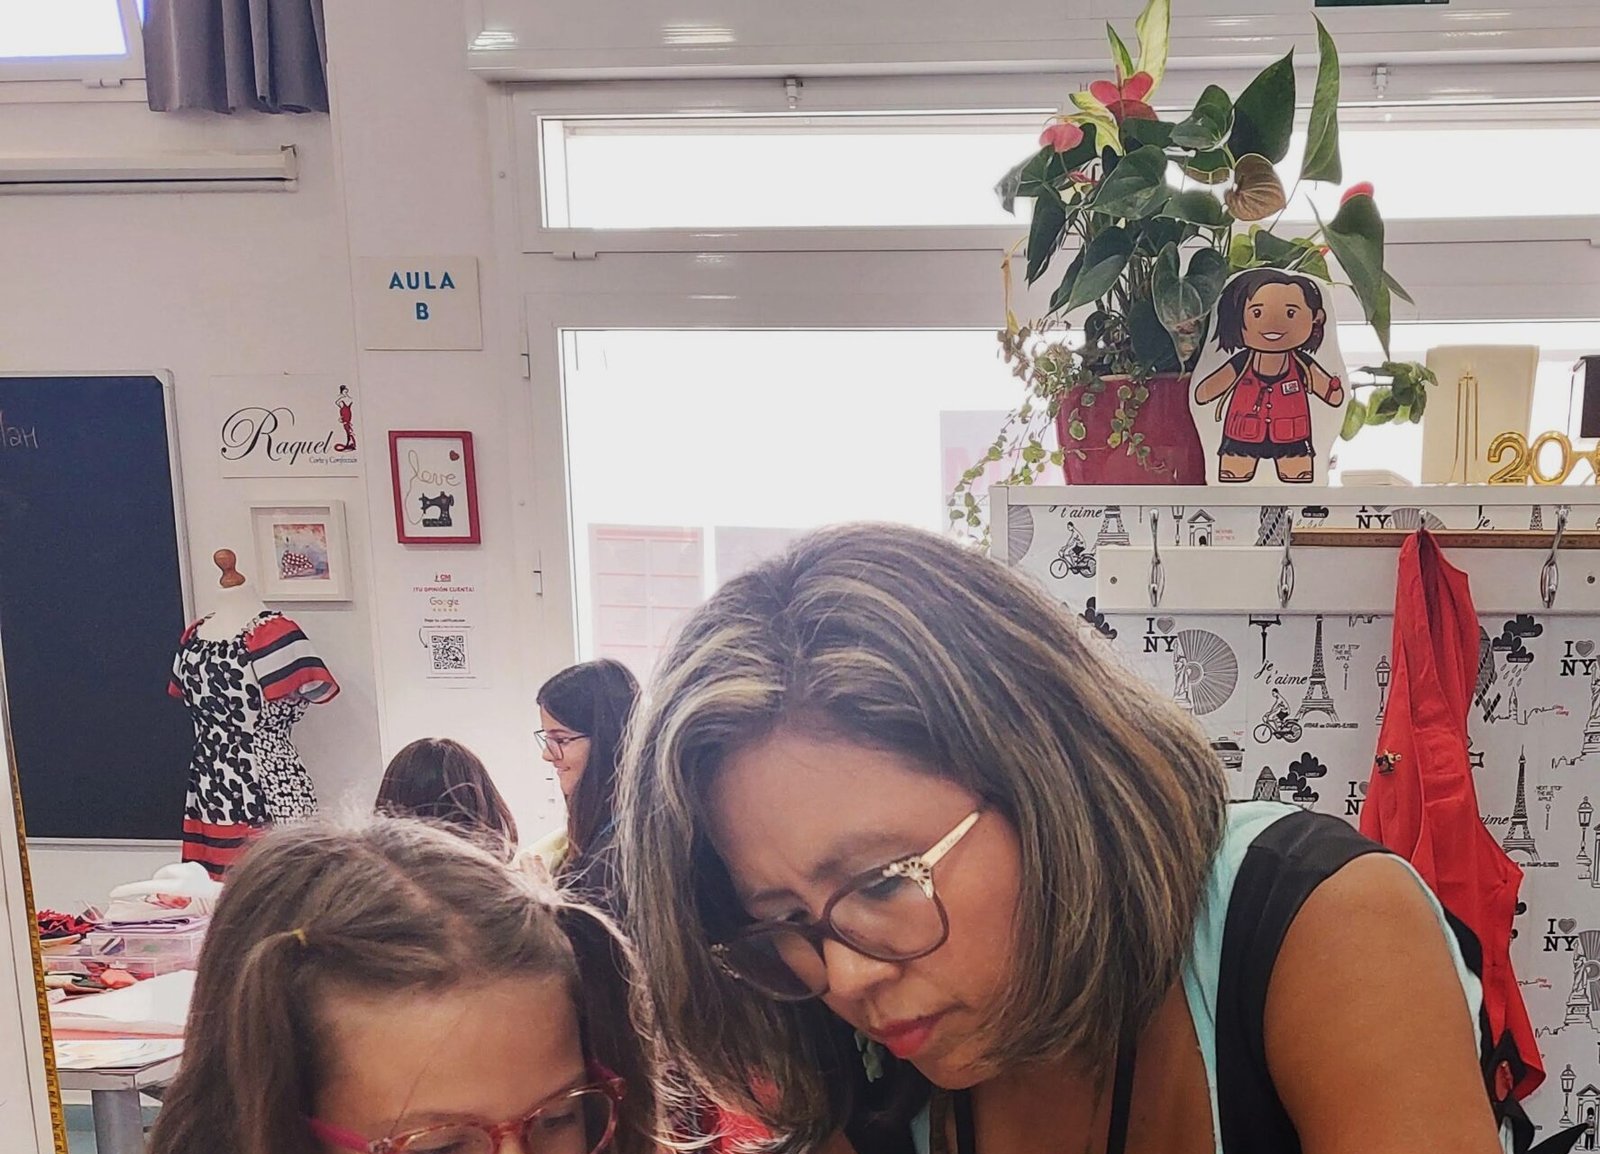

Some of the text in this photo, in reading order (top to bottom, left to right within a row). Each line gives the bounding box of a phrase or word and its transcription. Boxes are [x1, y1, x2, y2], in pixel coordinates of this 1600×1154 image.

[389, 271, 455, 290] AULA
[416, 302, 429, 321] B
[220, 407, 334, 465] Raquel
[1487, 431, 1600, 485] 20
[407, 449, 461, 487] love
[1355, 515, 1392, 529] NY
[1146, 617, 1156, 634] I
[1143, 636, 1178, 652] NY
[1564, 641, 1574, 658] I
[1254, 660, 1274, 680] je
[1560, 659, 1597, 676] NY
[1265, 671, 1308, 685] t'aime
[1348, 781, 1358, 798] I
[1344, 799, 1367, 816] N
[1547, 918, 1557, 935] I
[1543, 935, 1579, 952] NY
